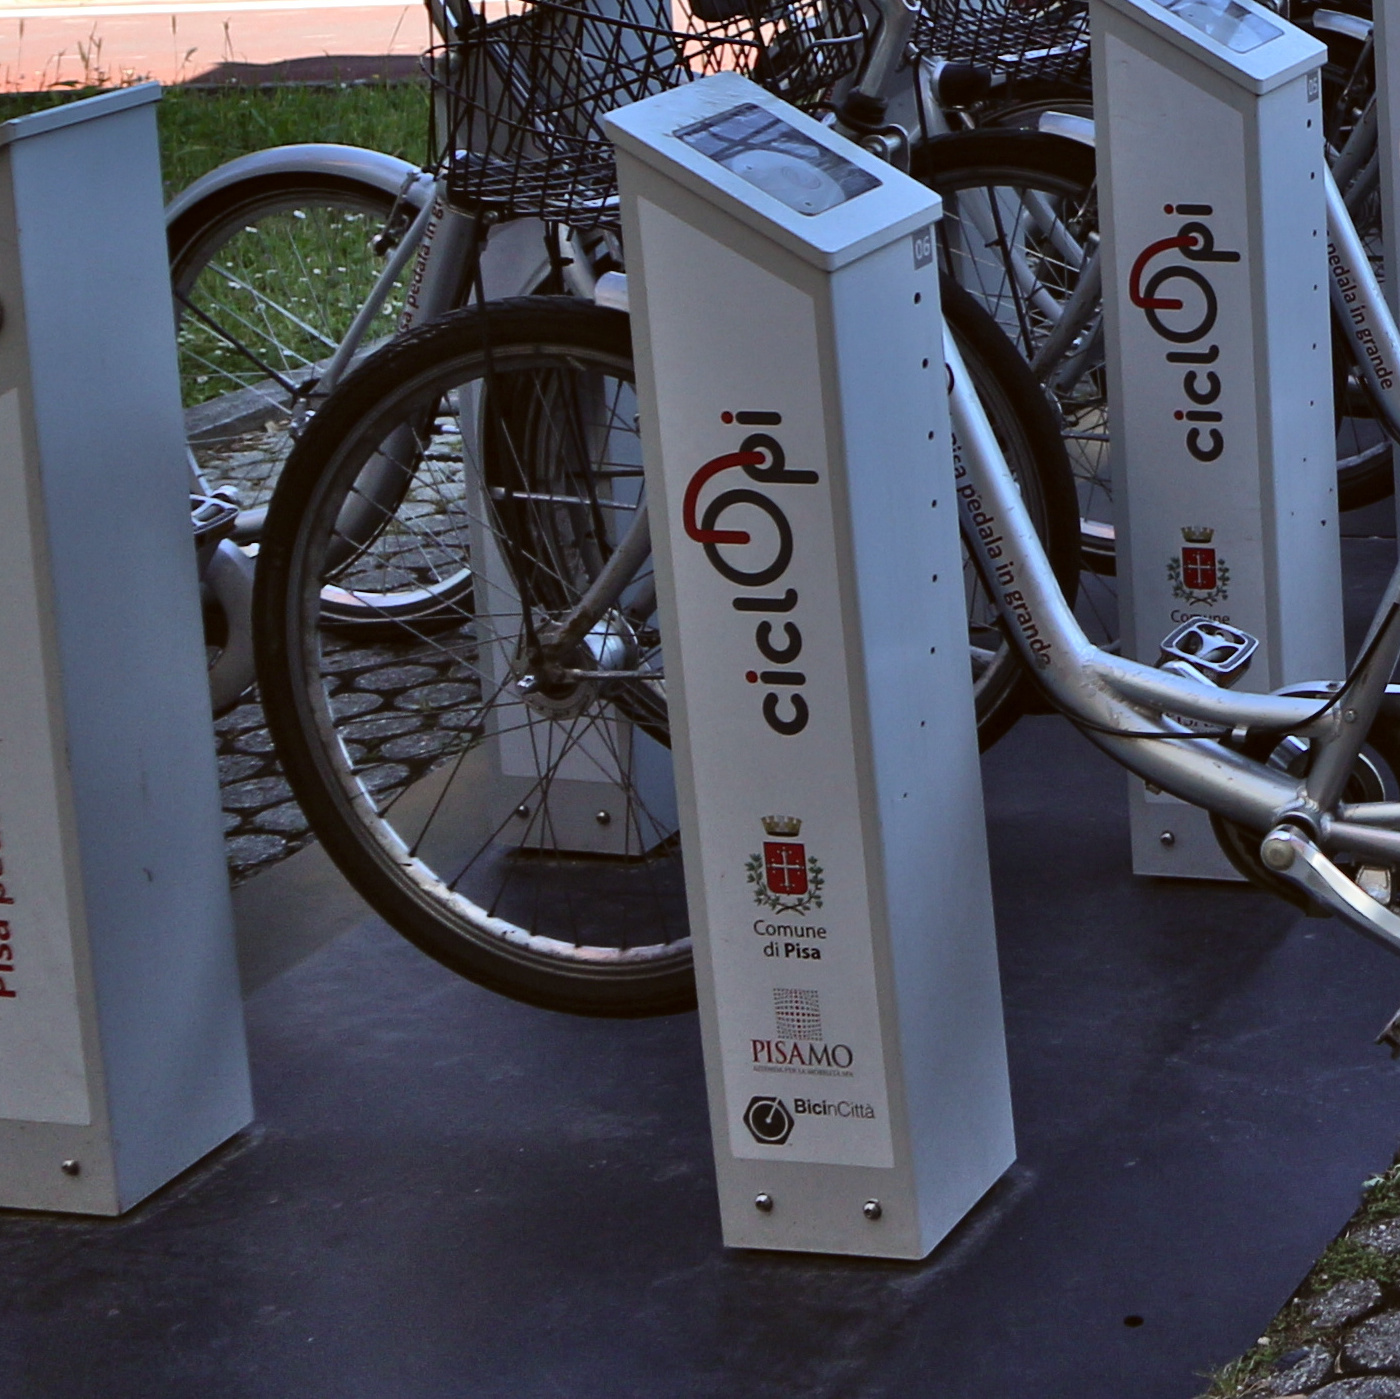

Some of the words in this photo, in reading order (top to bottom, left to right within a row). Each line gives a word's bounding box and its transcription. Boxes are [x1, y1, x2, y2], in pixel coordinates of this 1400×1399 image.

[915, 235, 931, 261] 06
[1350, 304, 1366, 325] in
[1355, 327, 1394, 390] grande
[956, 483, 1004, 560] pedala
[994, 560, 1015, 587] in
[753, 919, 828, 940] Comune
[763, 941, 780, 958] di
[783, 942, 822, 960] Pisa
[751, 1038, 854, 1069] PISAMO
[793, 1098, 876, 1121] BicinCittà
